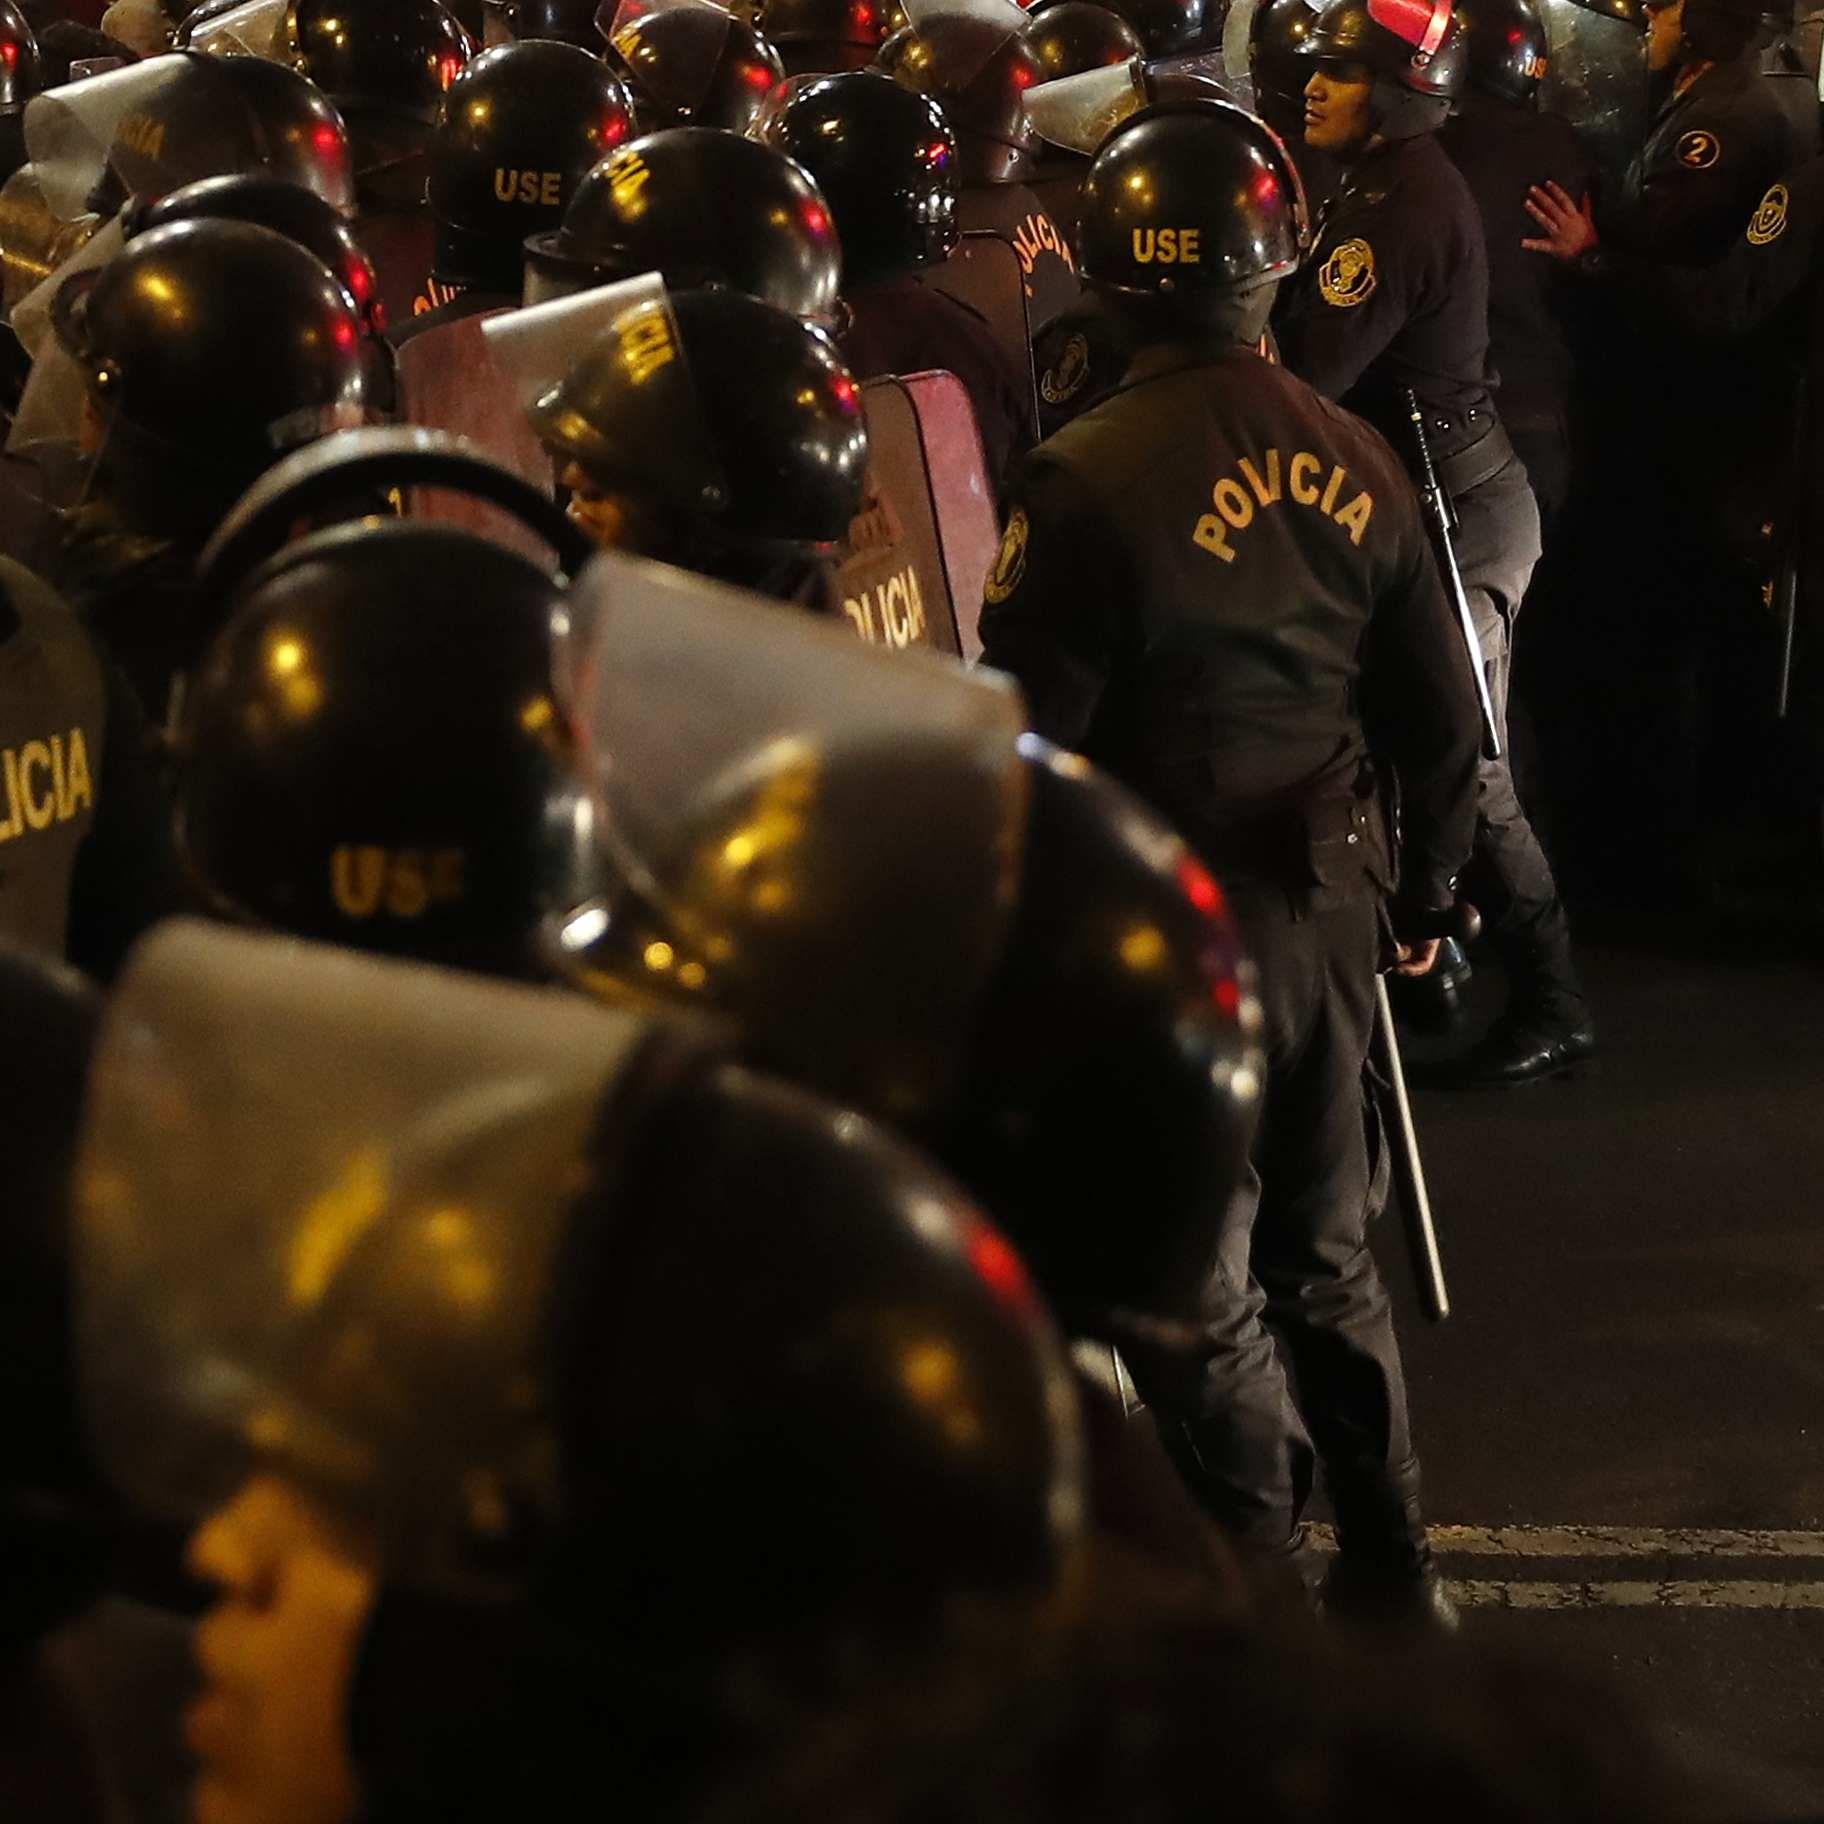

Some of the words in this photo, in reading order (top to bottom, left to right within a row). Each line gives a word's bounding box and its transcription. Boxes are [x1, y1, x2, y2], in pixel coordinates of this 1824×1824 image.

[1683, 136, 1709, 163] 2
[494, 167, 561, 205] USE
[1131, 226, 1201, 264] USE
